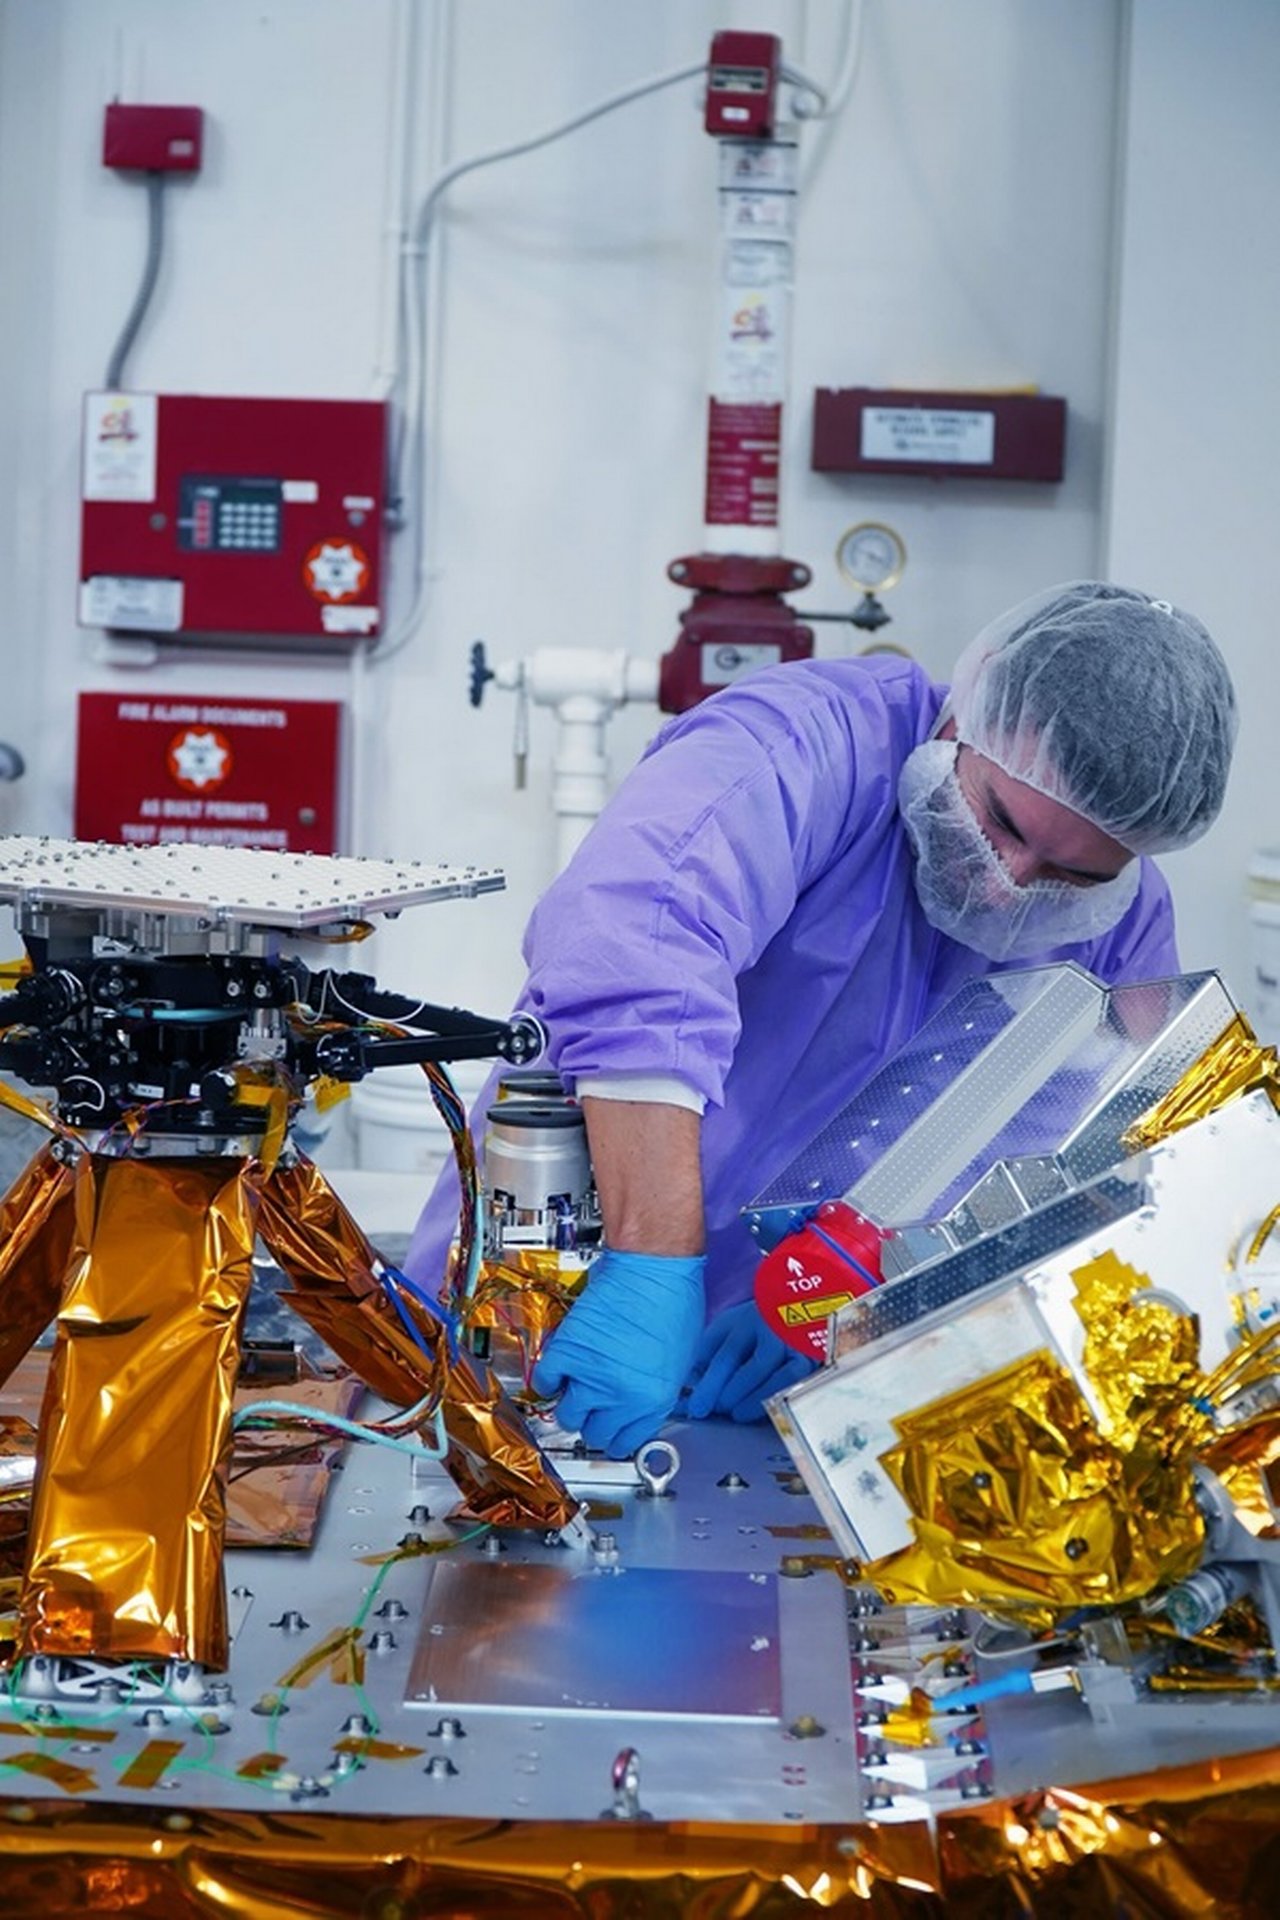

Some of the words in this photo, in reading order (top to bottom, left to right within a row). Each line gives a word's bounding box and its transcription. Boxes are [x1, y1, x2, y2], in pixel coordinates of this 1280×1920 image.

[118, 703, 149, 720] FIRE
[153, 704, 198, 723] ALARM
[202, 706, 287, 728] DOCUMENTS
[786, 1274, 822, 1293] TOP
